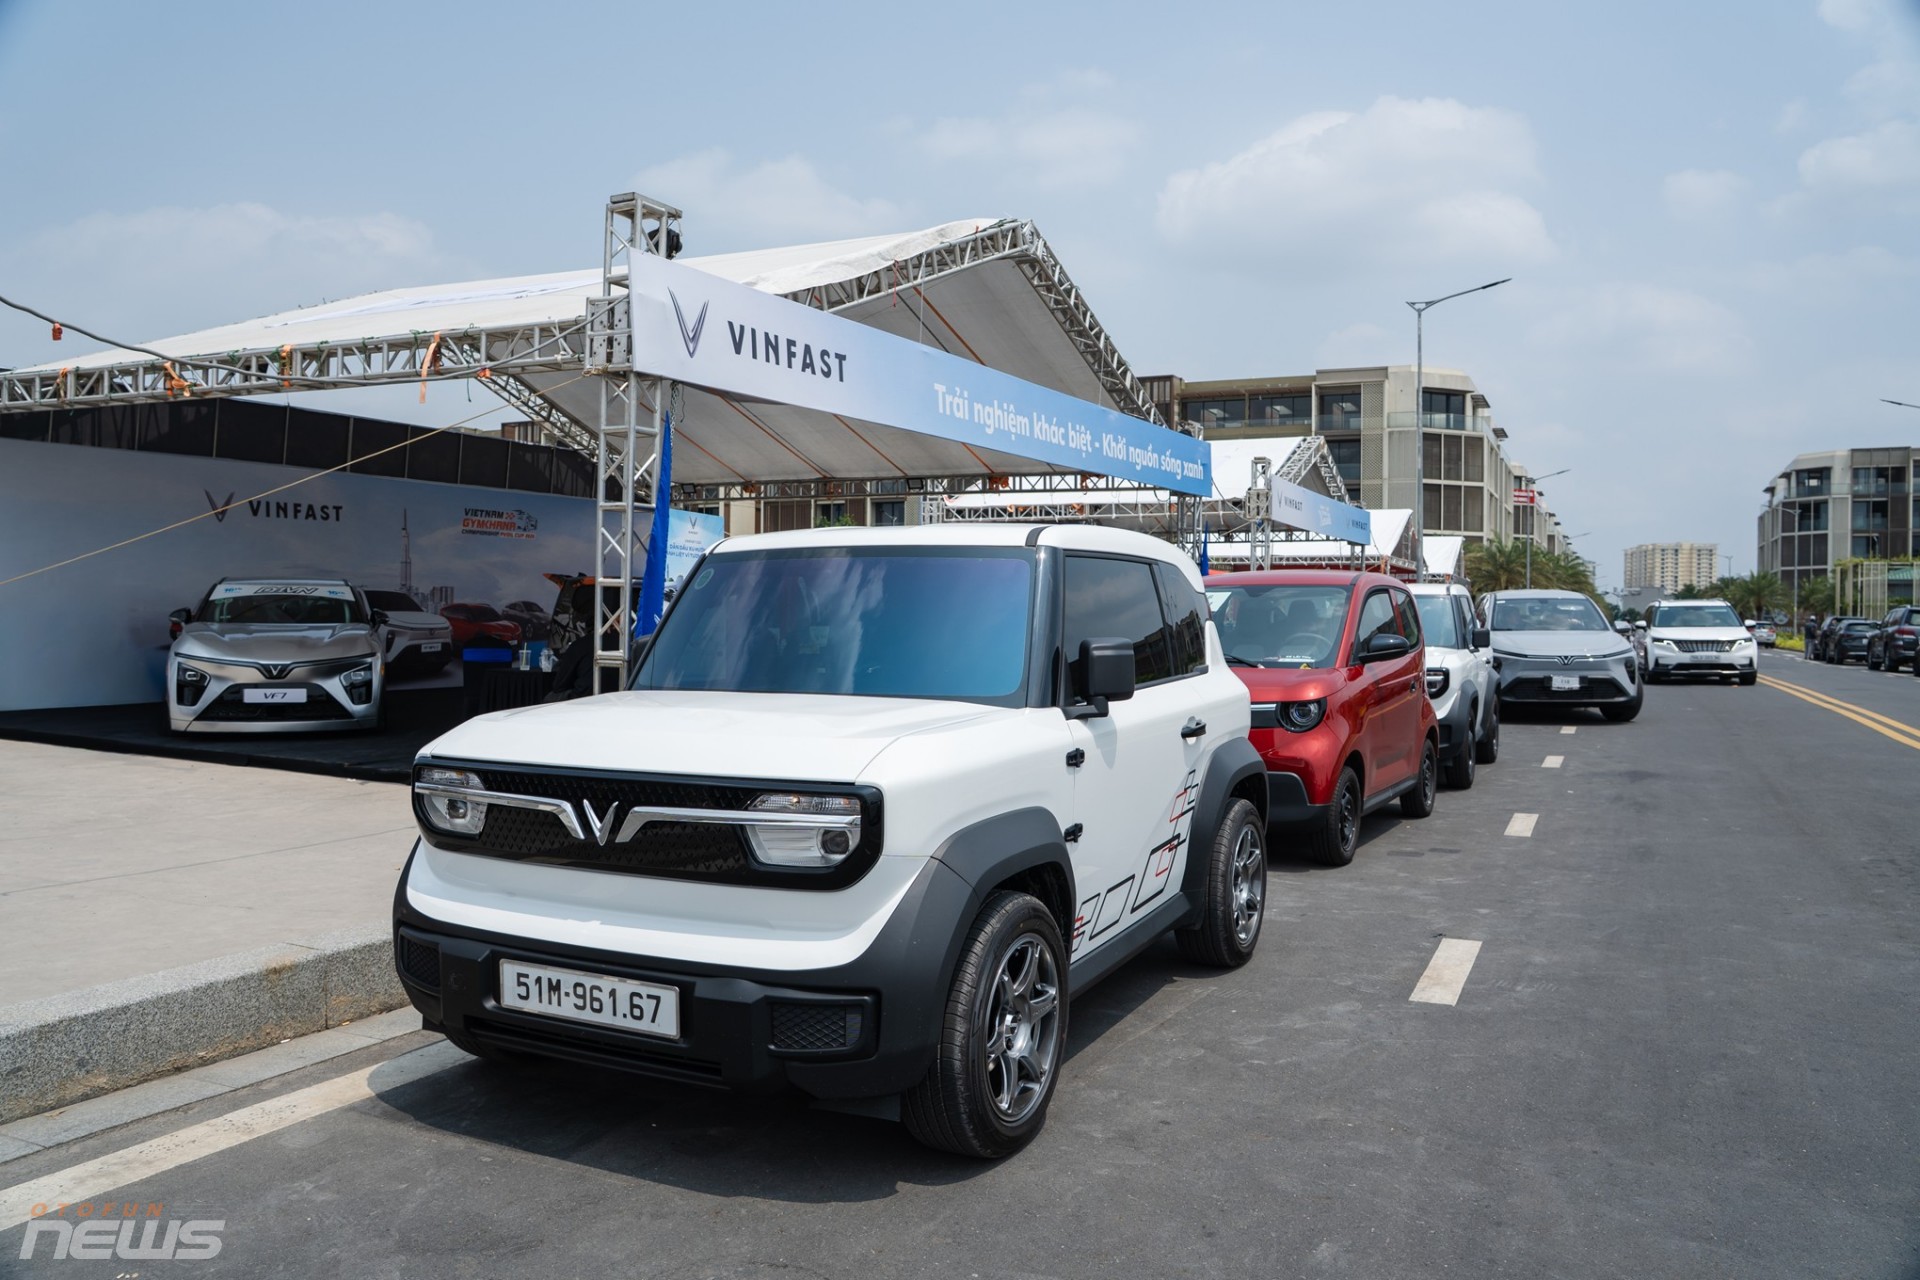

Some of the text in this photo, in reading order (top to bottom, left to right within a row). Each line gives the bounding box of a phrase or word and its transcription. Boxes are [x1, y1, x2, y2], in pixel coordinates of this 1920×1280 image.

[727, 320, 847, 383] VINFAST
[933, 382, 969, 421] Trải
[974, 400, 1030, 441] nghiệm
[1034, 411, 1066, 446] khác
[1068, 422, 1092, 458] biệt
[1102, 432, 1126, 461] Khởi
[1128, 443, 1159, 471] nguồn
[1161, 449, 1182, 480] sống
[1183, 459, 1204, 480] xanh
[248, 500, 343, 522] VINFAST
[462, 518, 517, 531] GYMKHANA
[464, 508, 504, 519] VIETNAM
[516, 972, 662, 1024] 51M-961.67
